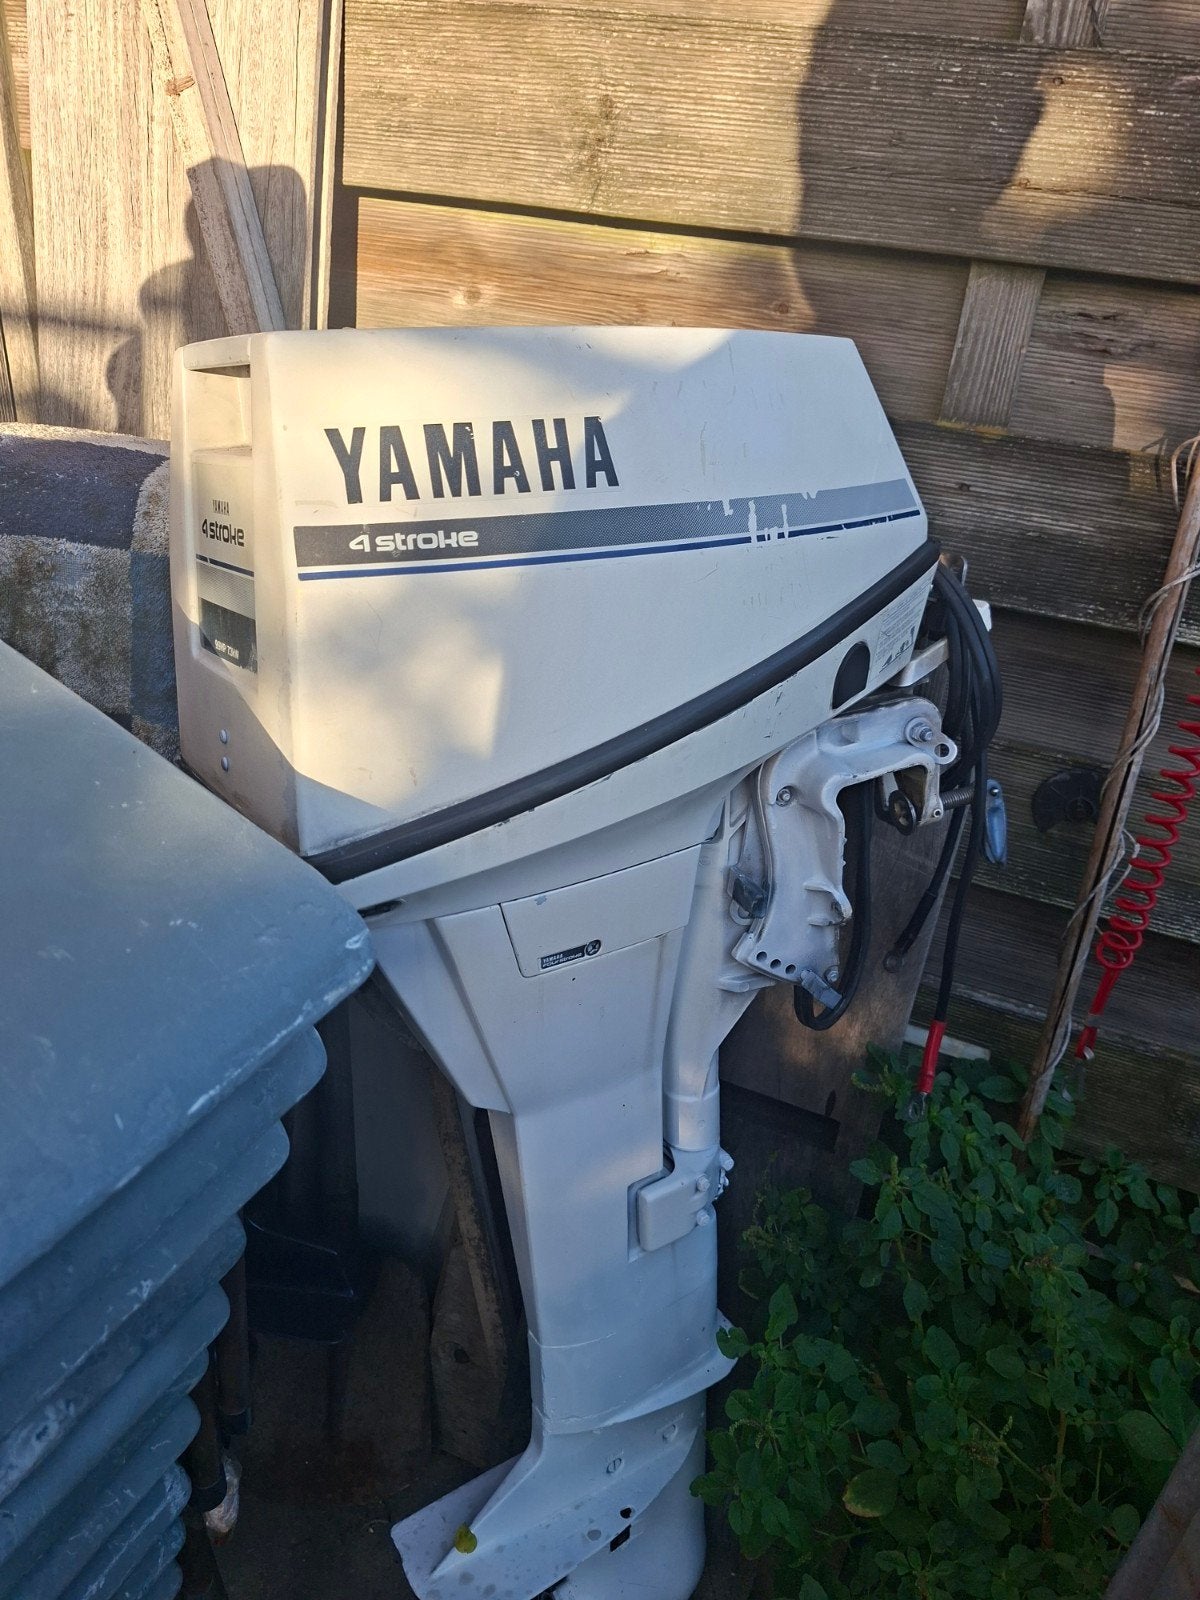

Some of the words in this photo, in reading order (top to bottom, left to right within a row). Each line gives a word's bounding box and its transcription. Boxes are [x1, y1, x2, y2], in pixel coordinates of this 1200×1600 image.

[323, 415, 620, 505] YAMAHA
[202, 518, 209, 539] 4
[209, 521, 245, 547] stroke
[348, 533, 371, 553] 4
[375, 530, 479, 552] stroke
